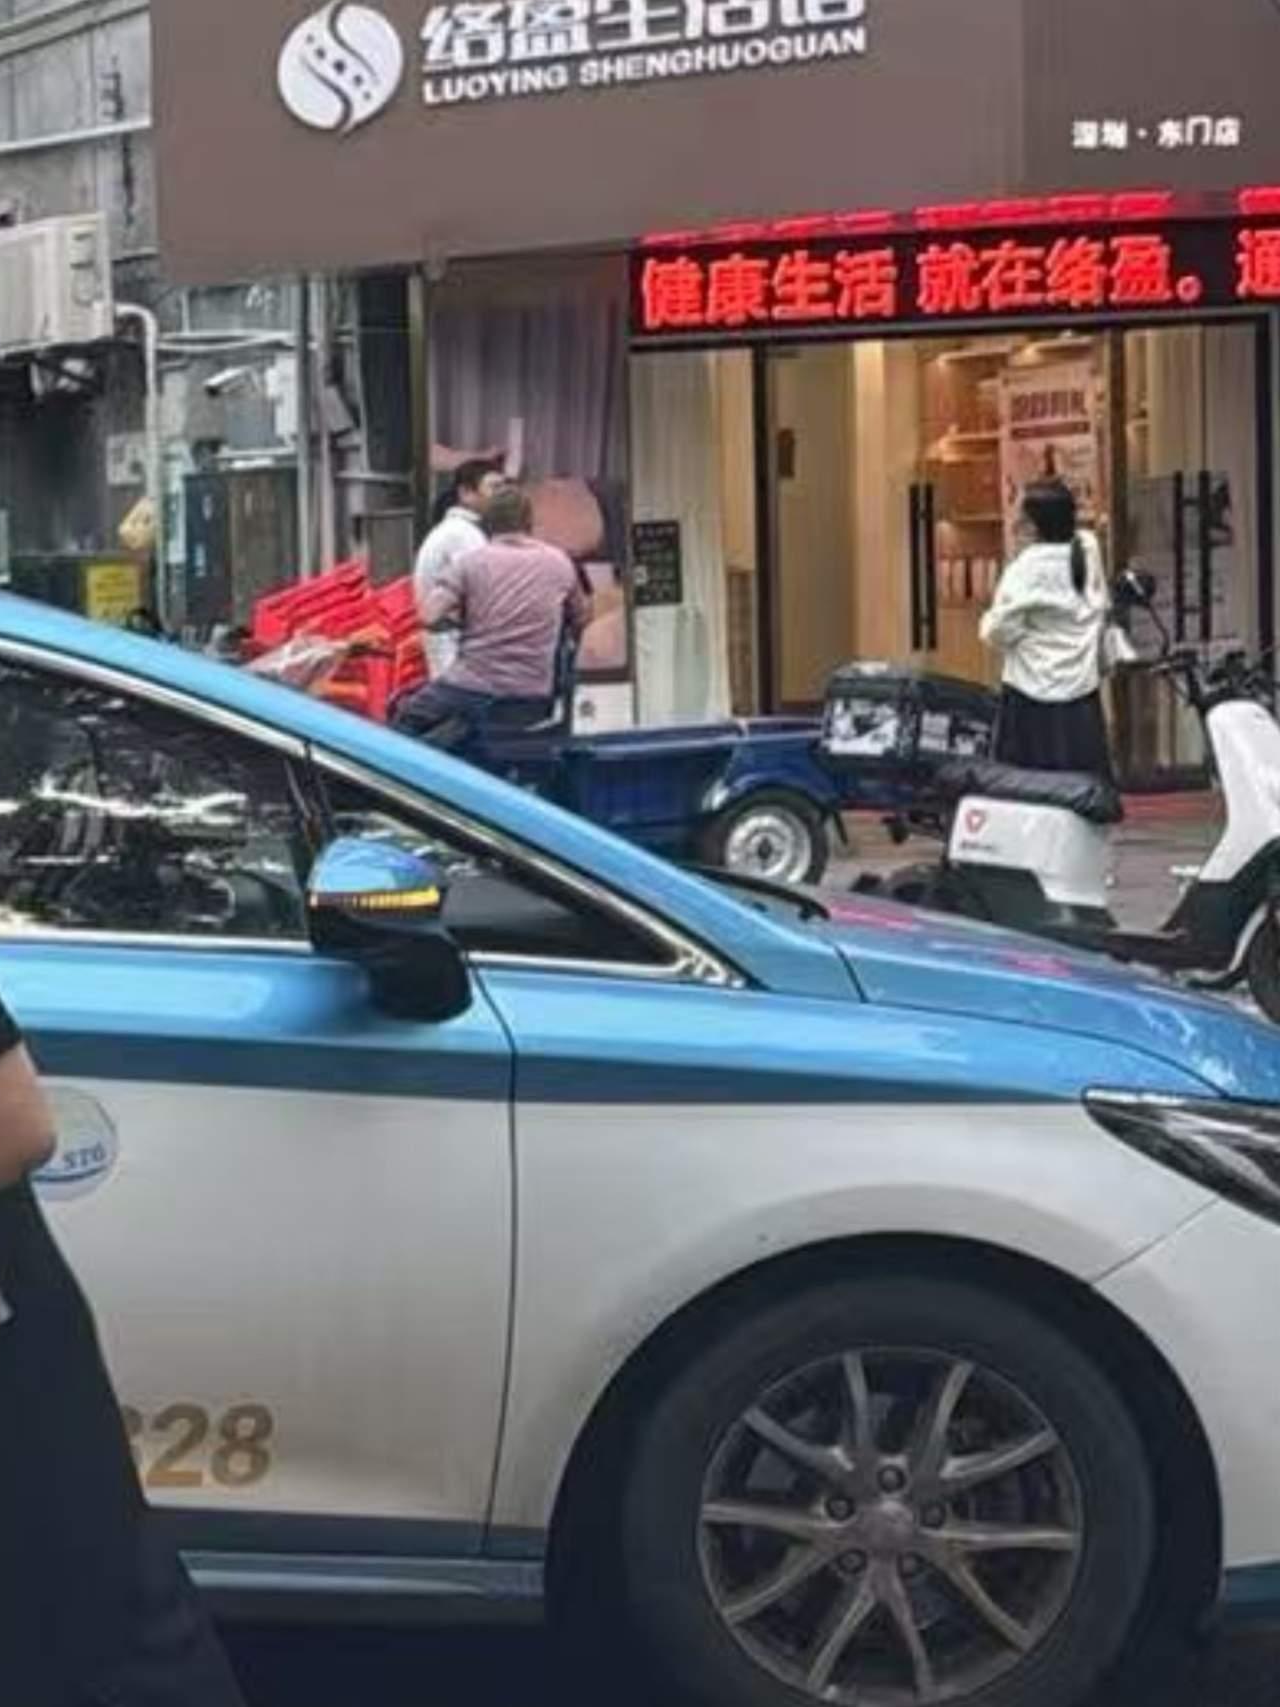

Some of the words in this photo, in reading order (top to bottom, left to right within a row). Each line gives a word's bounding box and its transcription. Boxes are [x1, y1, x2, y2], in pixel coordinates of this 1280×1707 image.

[423, 64, 568, 104] LUOYING
[579, 27, 865, 85] SHENGHUOGUAN
[641, 248, 897, 329] 健康生活
